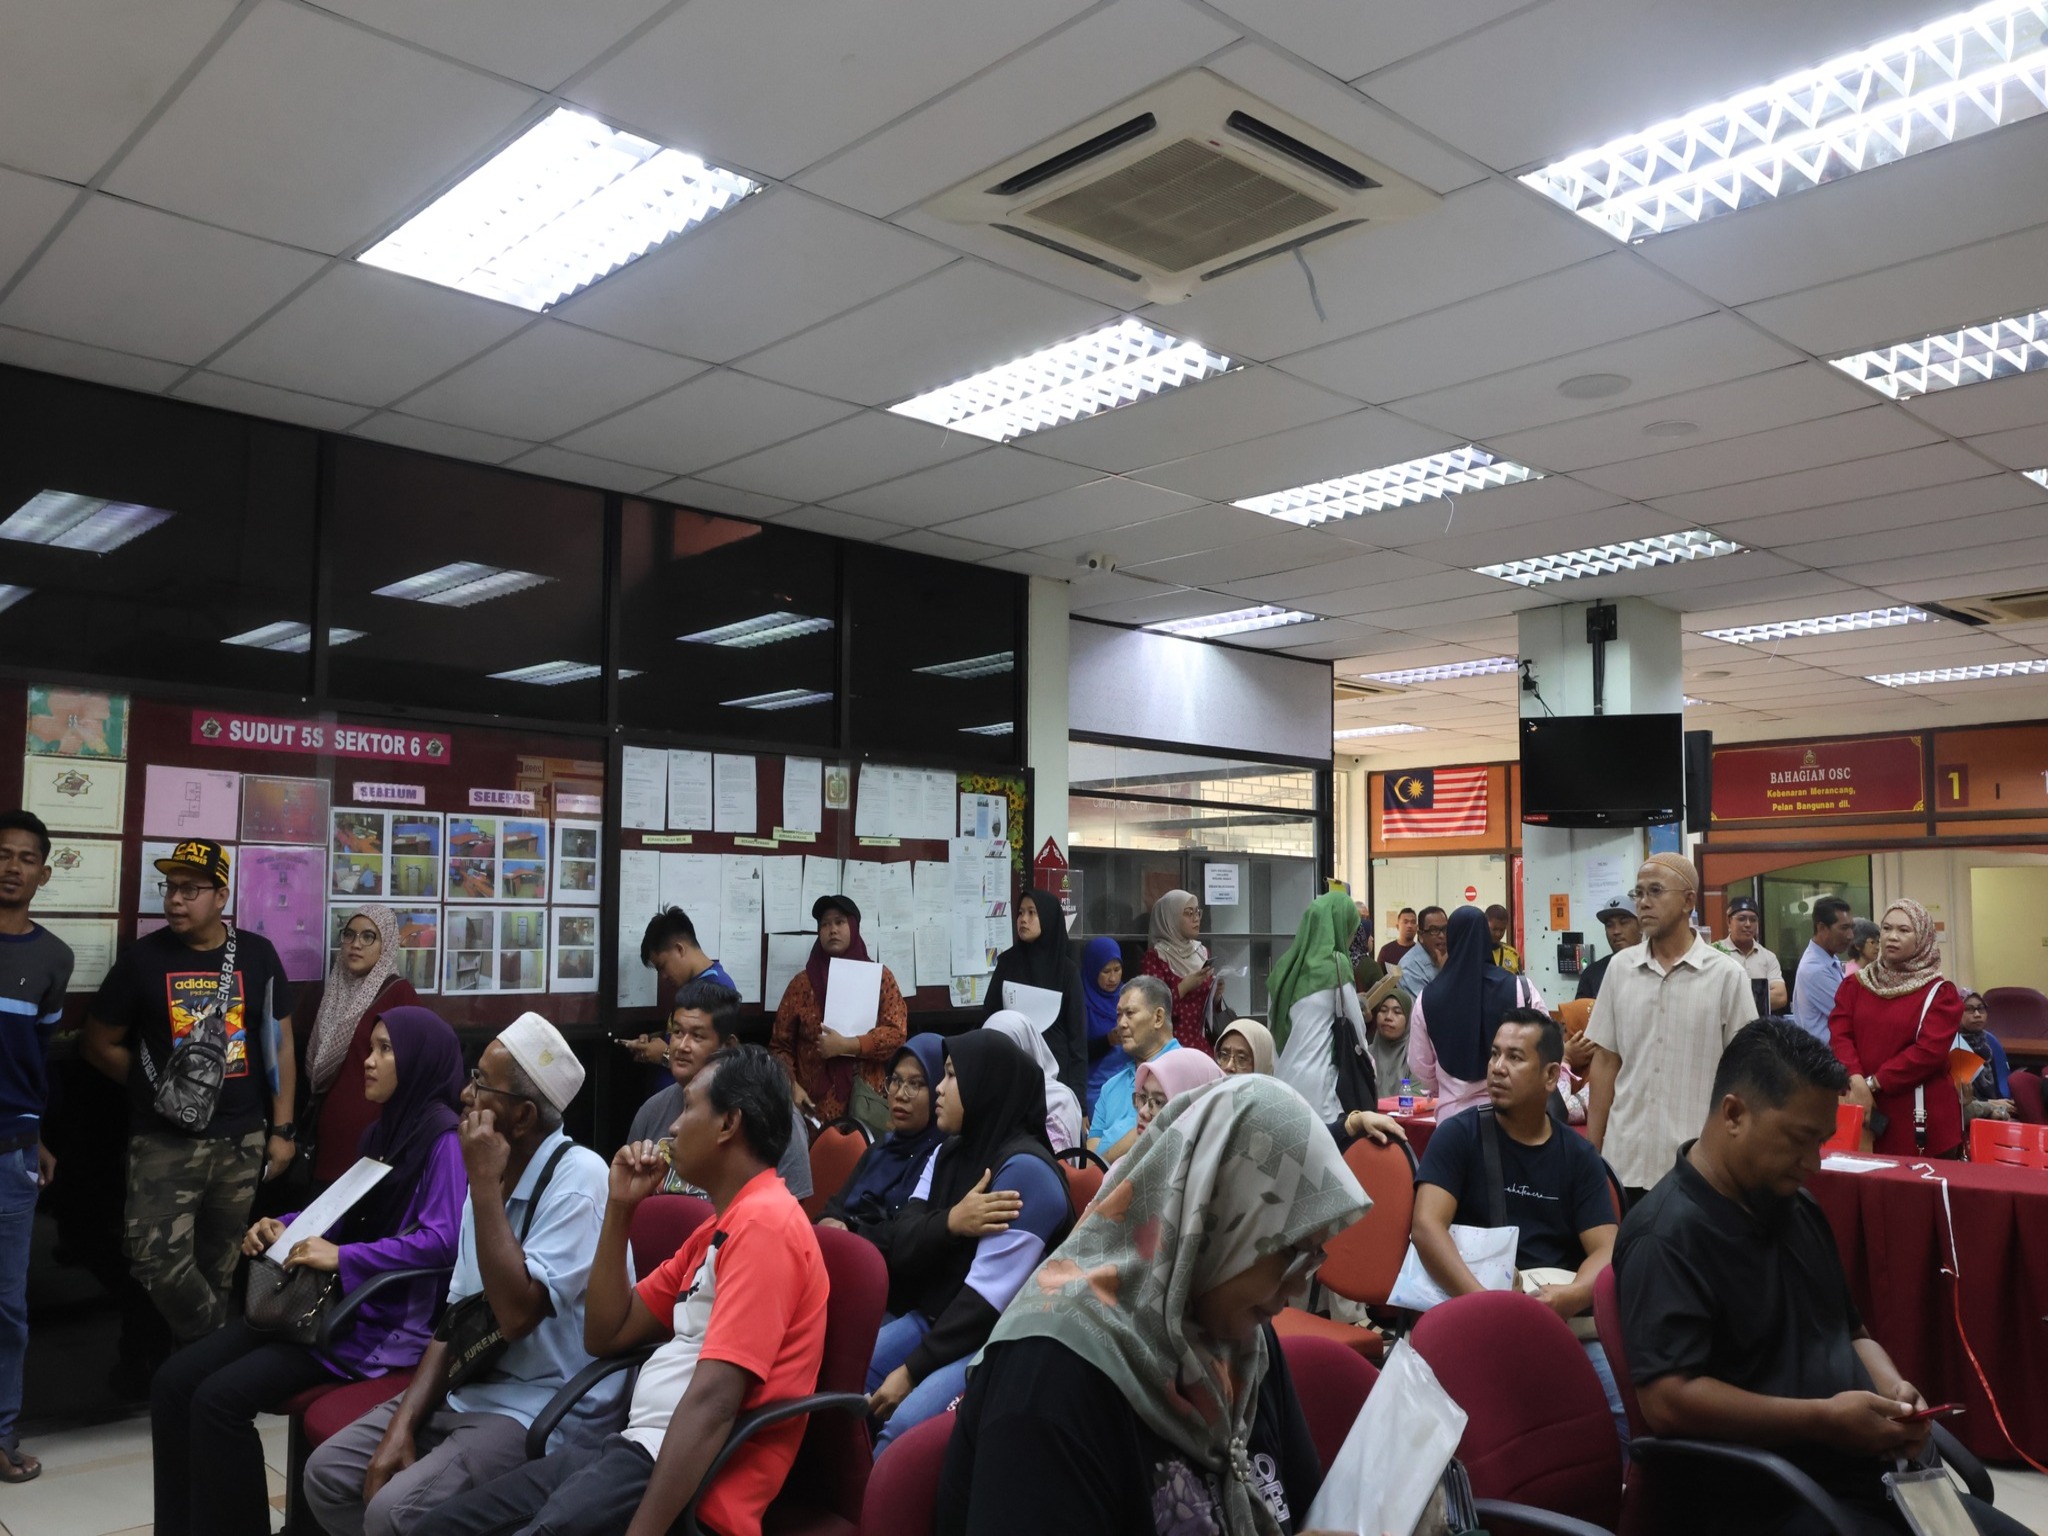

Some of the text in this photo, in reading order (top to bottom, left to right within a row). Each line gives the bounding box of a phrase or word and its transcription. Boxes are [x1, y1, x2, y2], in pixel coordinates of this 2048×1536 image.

[229, 720, 421, 757] SUDUT 5S SEKTOR 6
[1770, 767, 1851, 784] BAHAGIAN OSC
[360, 785, 417, 800] SEBELUM
[1767, 789, 1807, 798] Kebenaran
[1948, 772, 1960, 800] 1
[473, 790, 530, 806] SELEPAS
[1772, 803, 1794, 811] Pelan
[1796, 801, 1835, 811] Bangunan
[176, 842, 211, 857] CAT
[175, 978, 218, 990] adidas
[464, 1329, 503, 1362] SUPREME
